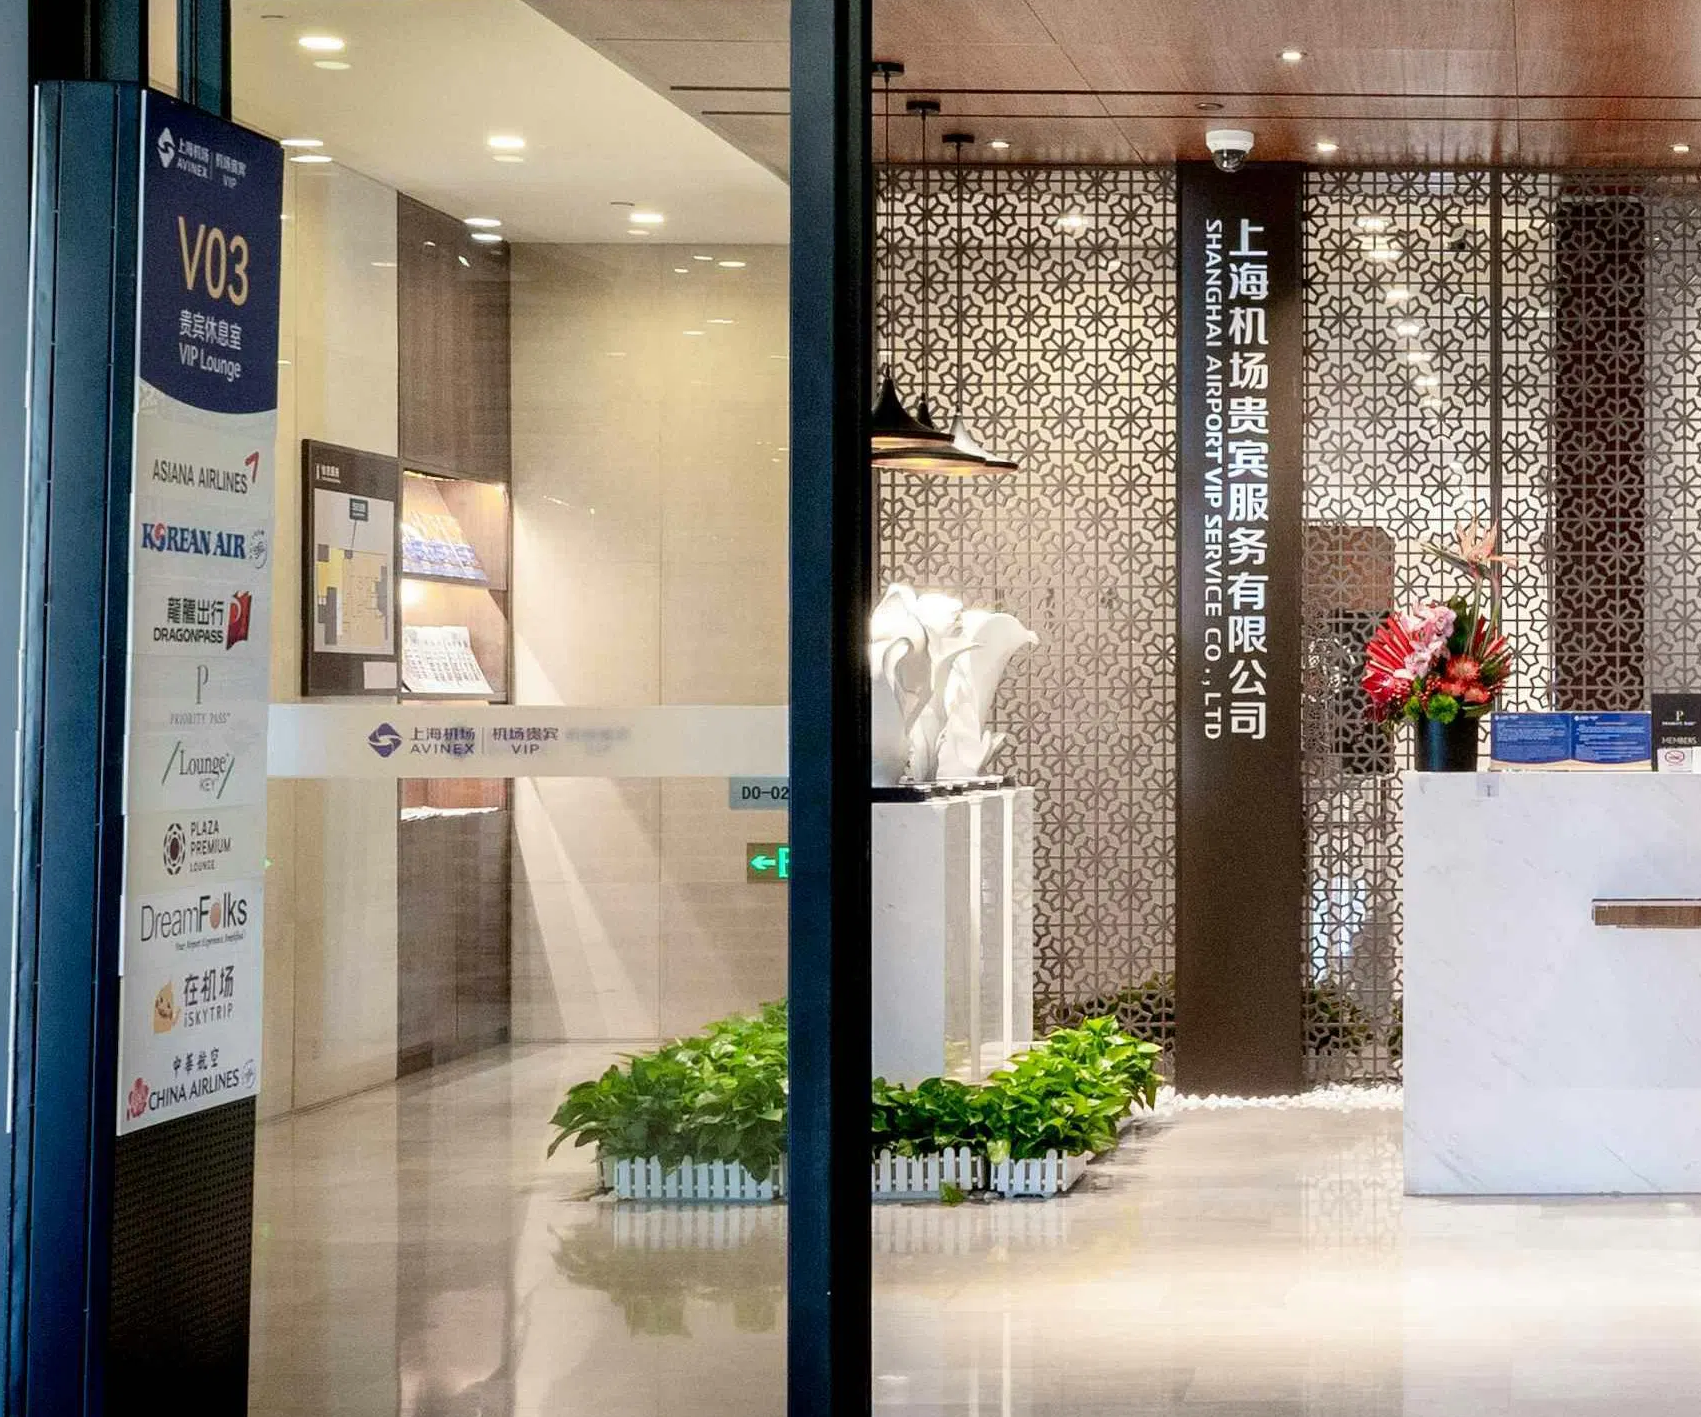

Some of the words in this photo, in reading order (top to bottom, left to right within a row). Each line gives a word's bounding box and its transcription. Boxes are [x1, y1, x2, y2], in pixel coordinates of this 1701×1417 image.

[177, 157, 209, 179] AVINEX
[179, 215, 249, 307] V03
[1205, 218, 1222, 347] SHANGHAI
[179, 309, 242, 351] 贵宾休息室
[179, 342, 199, 367] VIP
[200, 348, 242, 383] Lounge
[1205, 355, 1223, 464] AIRPORT
[152, 459, 195, 487] ASIANA
[197, 466, 248, 495] AIRLINES
[1204, 466, 1223, 508] VIP
[1227, 218, 1270, 740] 上海机场贵宾服务有限公司
[141, 523, 211, 557] KOREAN
[213, 531, 247, 560] AIR
[1204, 514, 1223, 617] SERVICE
[153, 627, 224, 644] DRAGONPASS
[410, 727, 476, 741] 上海机场
[492, 726, 559, 741] 机场贵宾
[1204, 692, 1222, 740] LTD
[179, 750, 227, 776] Lounge
[410, 743, 475, 755] AVINEX
[511, 743, 540, 755] VIP
[190, 820, 220, 837] PLAZA
[190, 837, 232, 856] PREMIUM
[189, 860, 216, 872] LOUNGE
[140, 892, 248, 942] DreamFolks
[184, 965, 235, 1007] 在机场
[183, 1003, 234, 1028] iSKYTRIP
[172, 1046, 220, 1079] 中華航空
[149, 1083, 187, 1111] CHINA
[189, 1068, 240, 1100] AIRLINES
